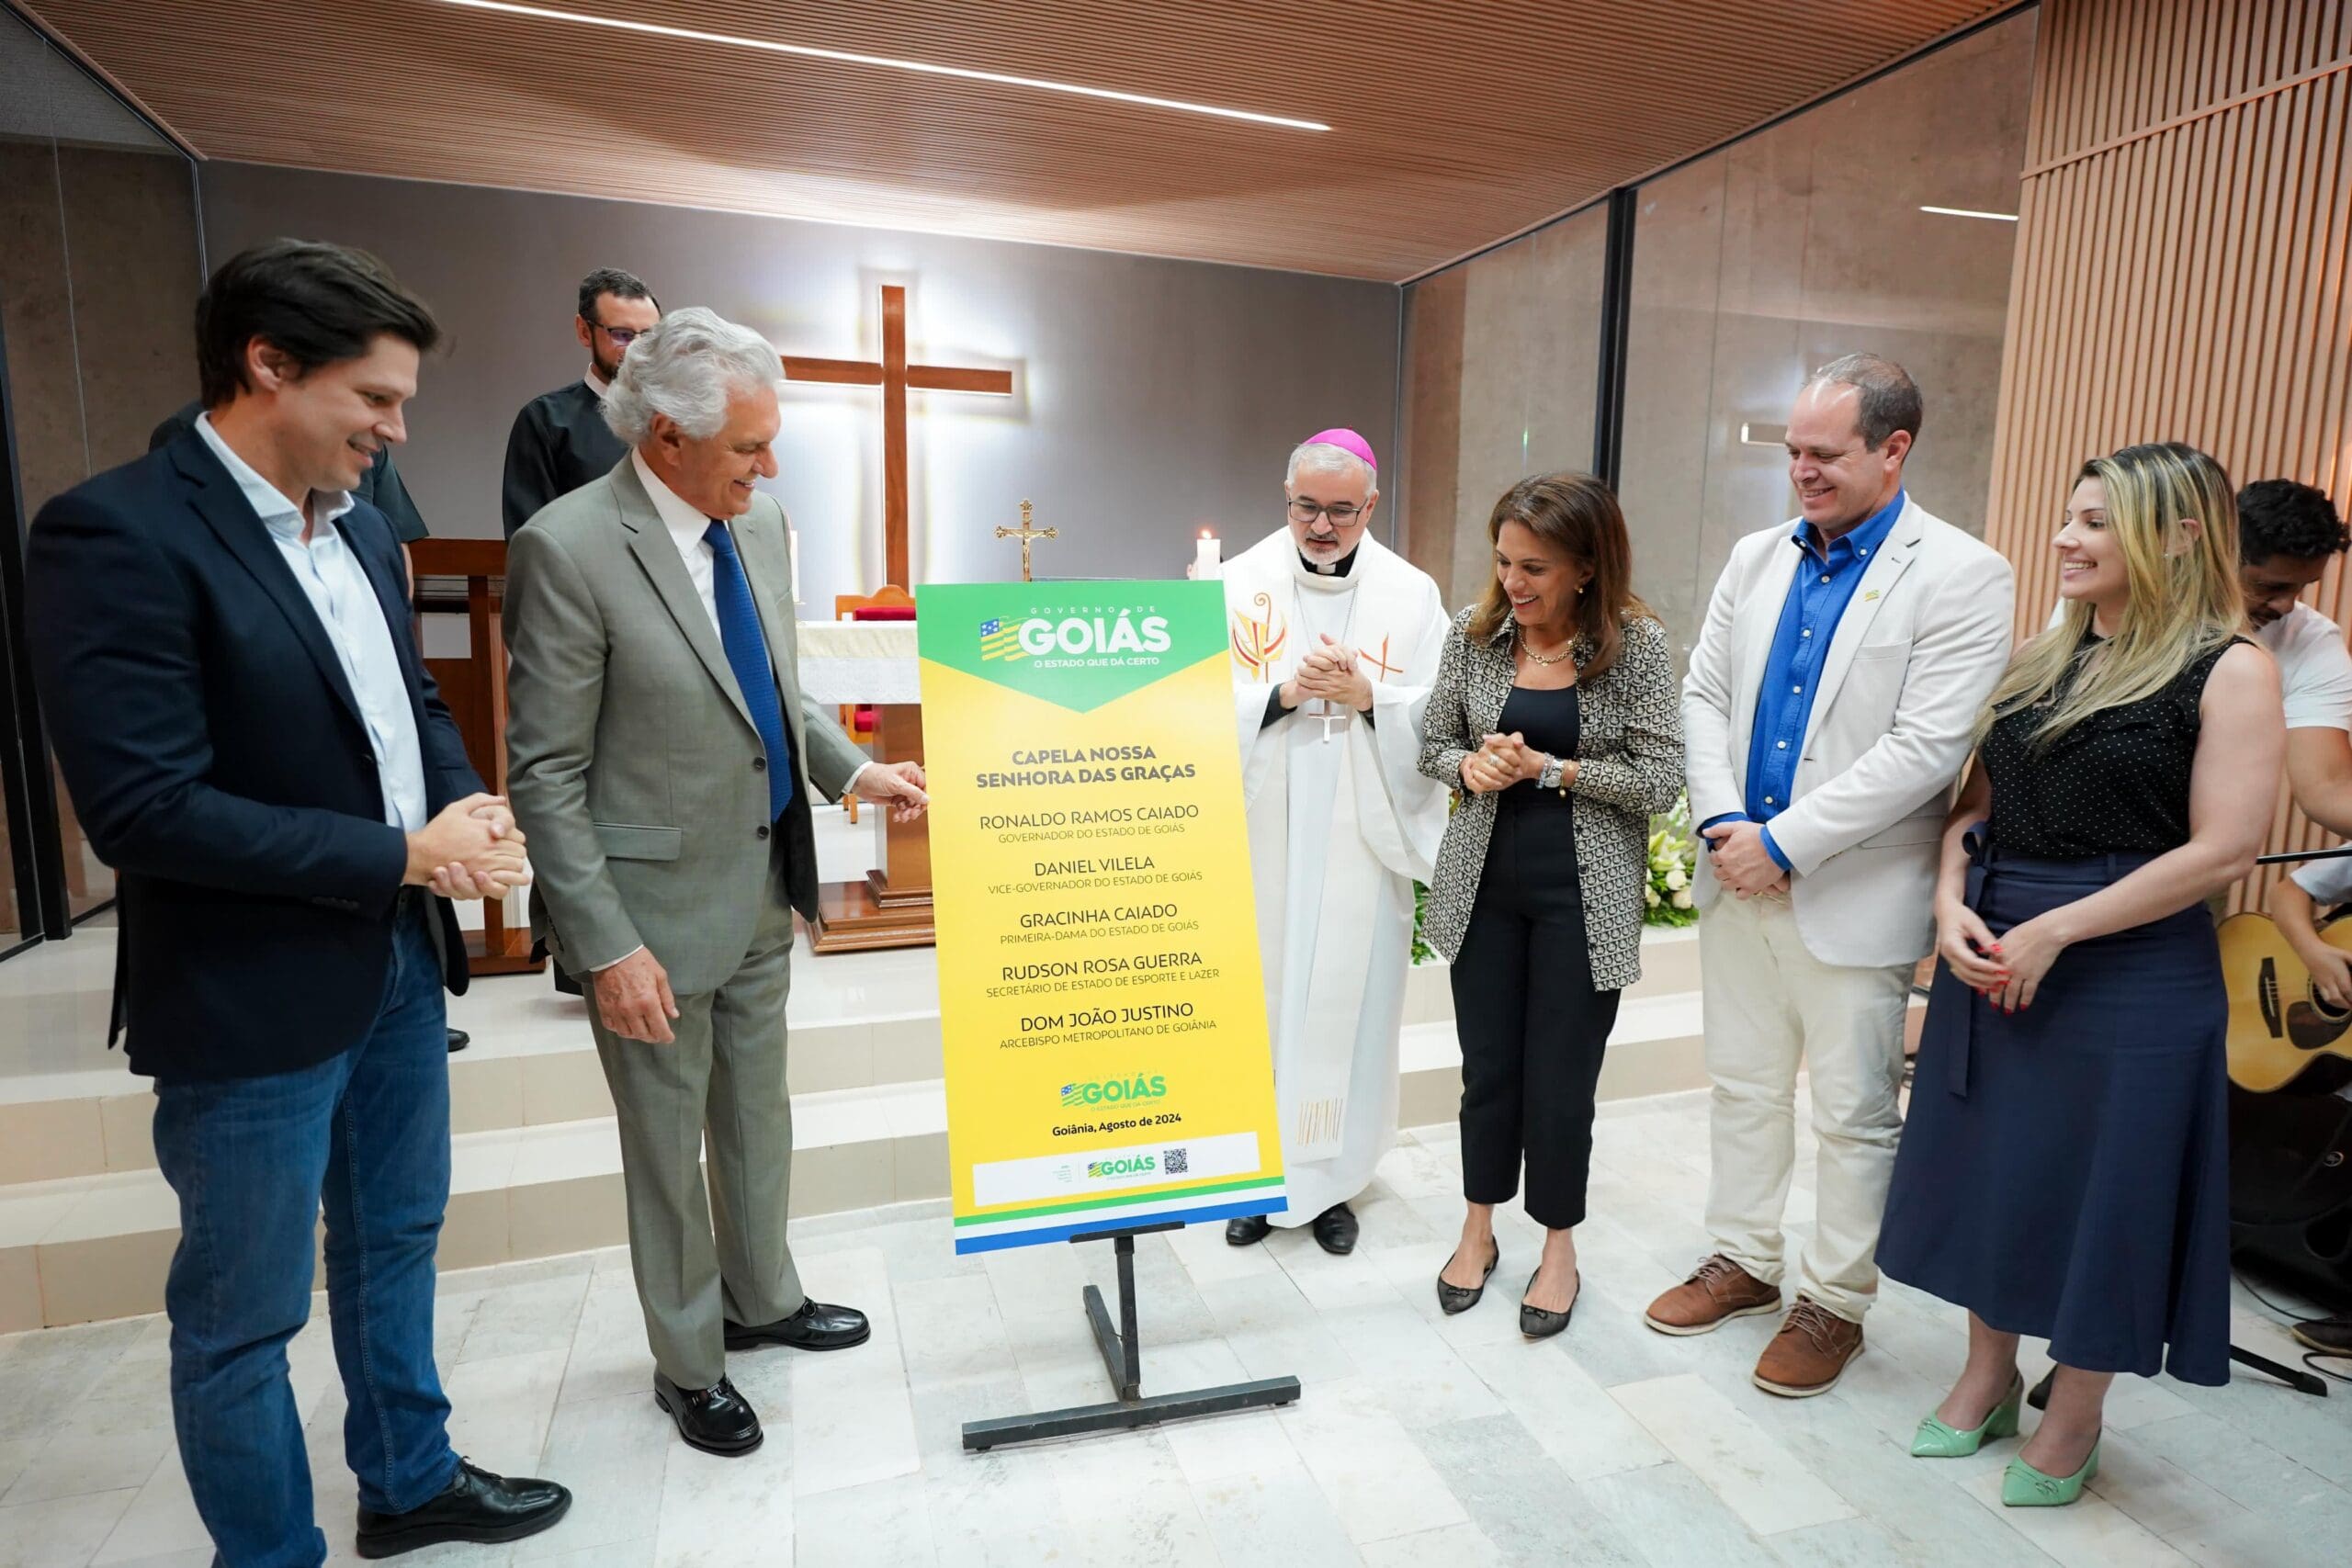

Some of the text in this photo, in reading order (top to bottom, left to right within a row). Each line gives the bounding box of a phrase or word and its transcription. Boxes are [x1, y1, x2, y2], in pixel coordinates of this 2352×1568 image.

[1018, 608, 1171, 656] GOIÁS
[1035, 656, 1159, 668] O ESTADO QUE DÁ CERTO
[1012, 745, 1156, 766] CAPELA NOSSA
[977, 763, 1195, 788] SENHORA DAS GRAÇAS
[980, 804, 1199, 829] RONALDO RAMOS CAIADO
[999, 823, 1184, 843] GOVERNADOR DO ESTADO DE GOIÁS
[1035, 856, 1155, 876] DANIEL VILELA
[989, 870, 1203, 895] VICE-GOVERNADOR DO ESTADO DE GOIÁS
[1020, 904, 1178, 929] GRACINHA CAIADO
[1001, 919, 1199, 944] PRIMEIRA-DAMA DO ESTADO DE GOIÁS
[1002, 952, 1202, 981] RUDSON ROSA GUERRA
[987, 969, 1219, 998] SECRETÁRIO DE ESTADO DE ESPORTE E LAZER
[1022, 1002, 1193, 1032] DOM JOÃO JUSTINO
[1000, 1020, 1216, 1049] ARCEBISPO METROPOLITANO DE GOIÂNIA
[1082, 1073, 1166, 1104] GOIÁS
[1052, 1113, 1182, 1136] Goiânia, Agosto de 2024
[1102, 1155, 1156, 1176] GOIÁS
